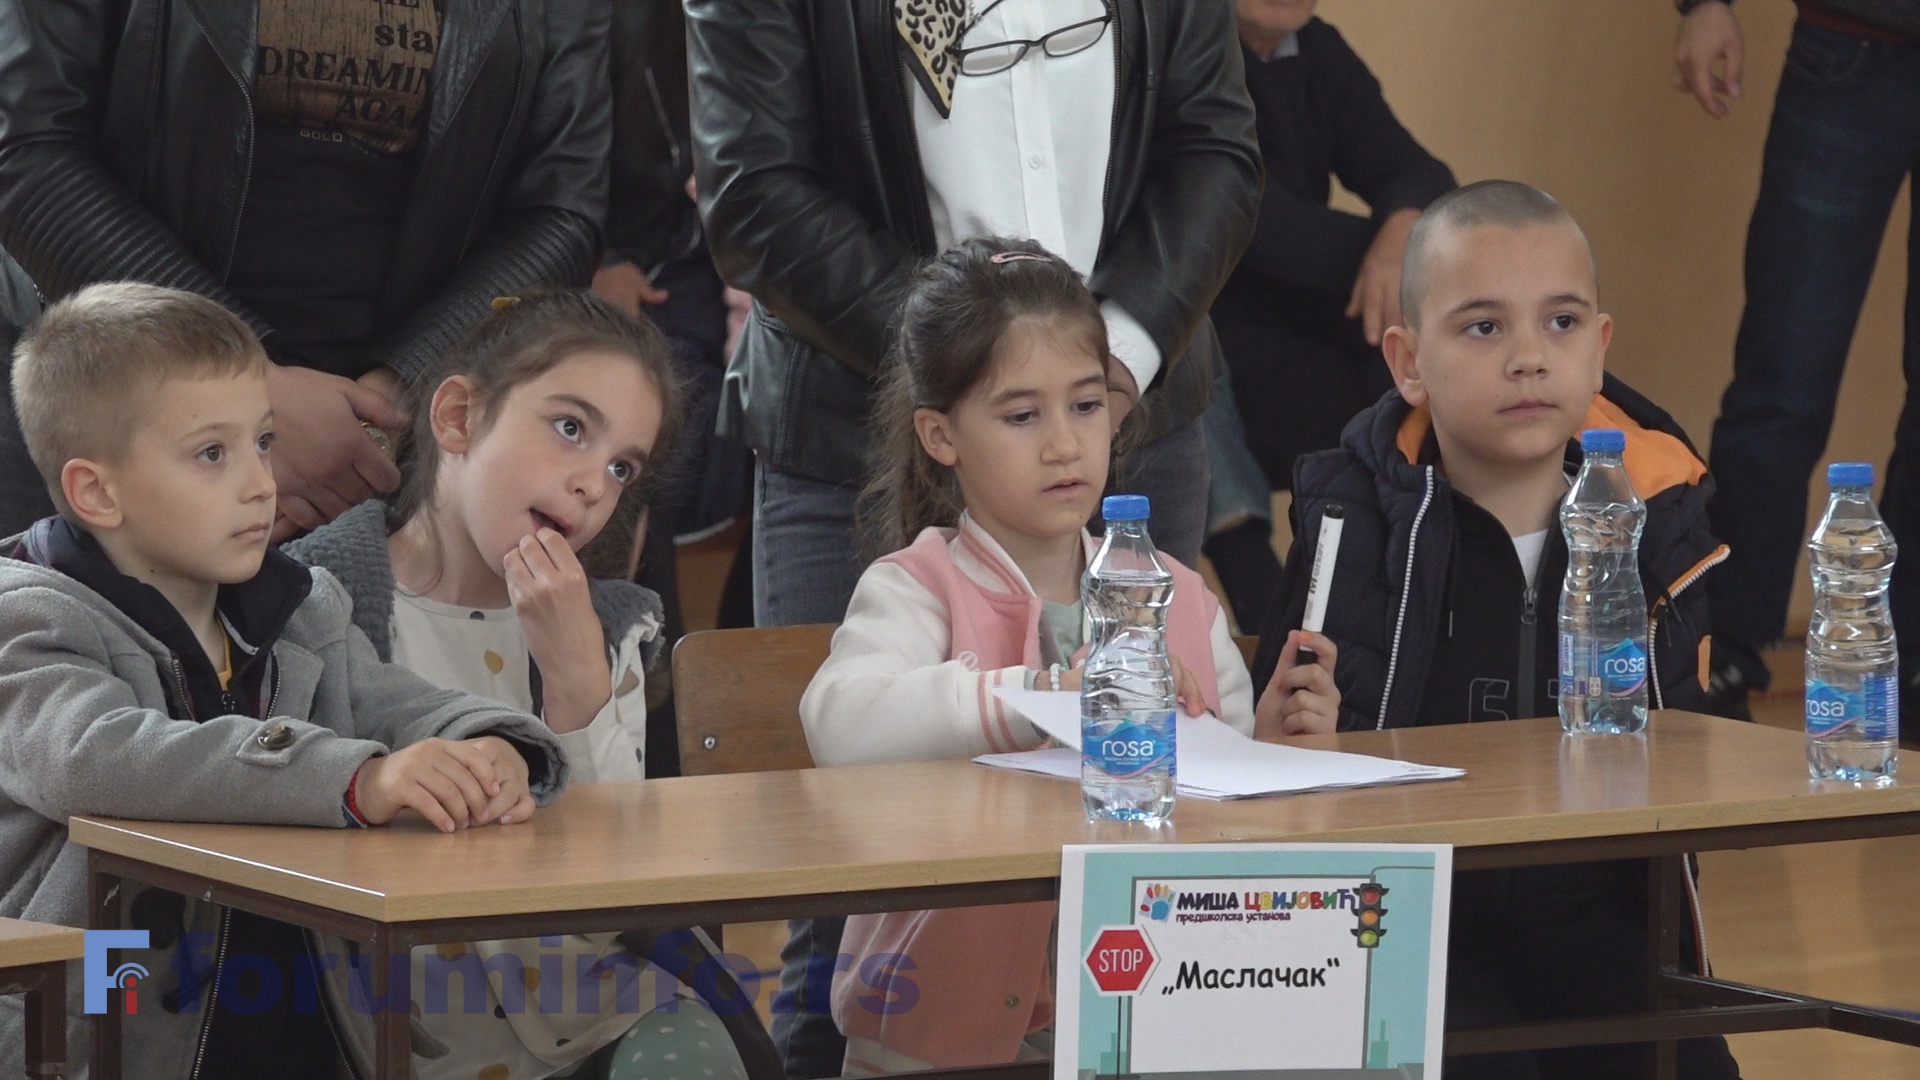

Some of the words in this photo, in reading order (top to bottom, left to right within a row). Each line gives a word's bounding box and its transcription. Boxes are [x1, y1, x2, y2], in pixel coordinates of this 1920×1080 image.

[374, 23, 440, 54] sta
[300, 128, 343, 143] GOLD
[1605, 656, 1646, 674] rosa
[1806, 699, 1845, 717] rosa
[1102, 740, 1154, 757] rosa
[1176, 892, 1239, 911] МИША
[1244, 888, 1357, 912] ЦВИЈОВИЋ
[1176, 911, 1244, 925] предшколска
[1246, 911, 1291, 924] установа
[1098, 948, 1144, 973] STOP
